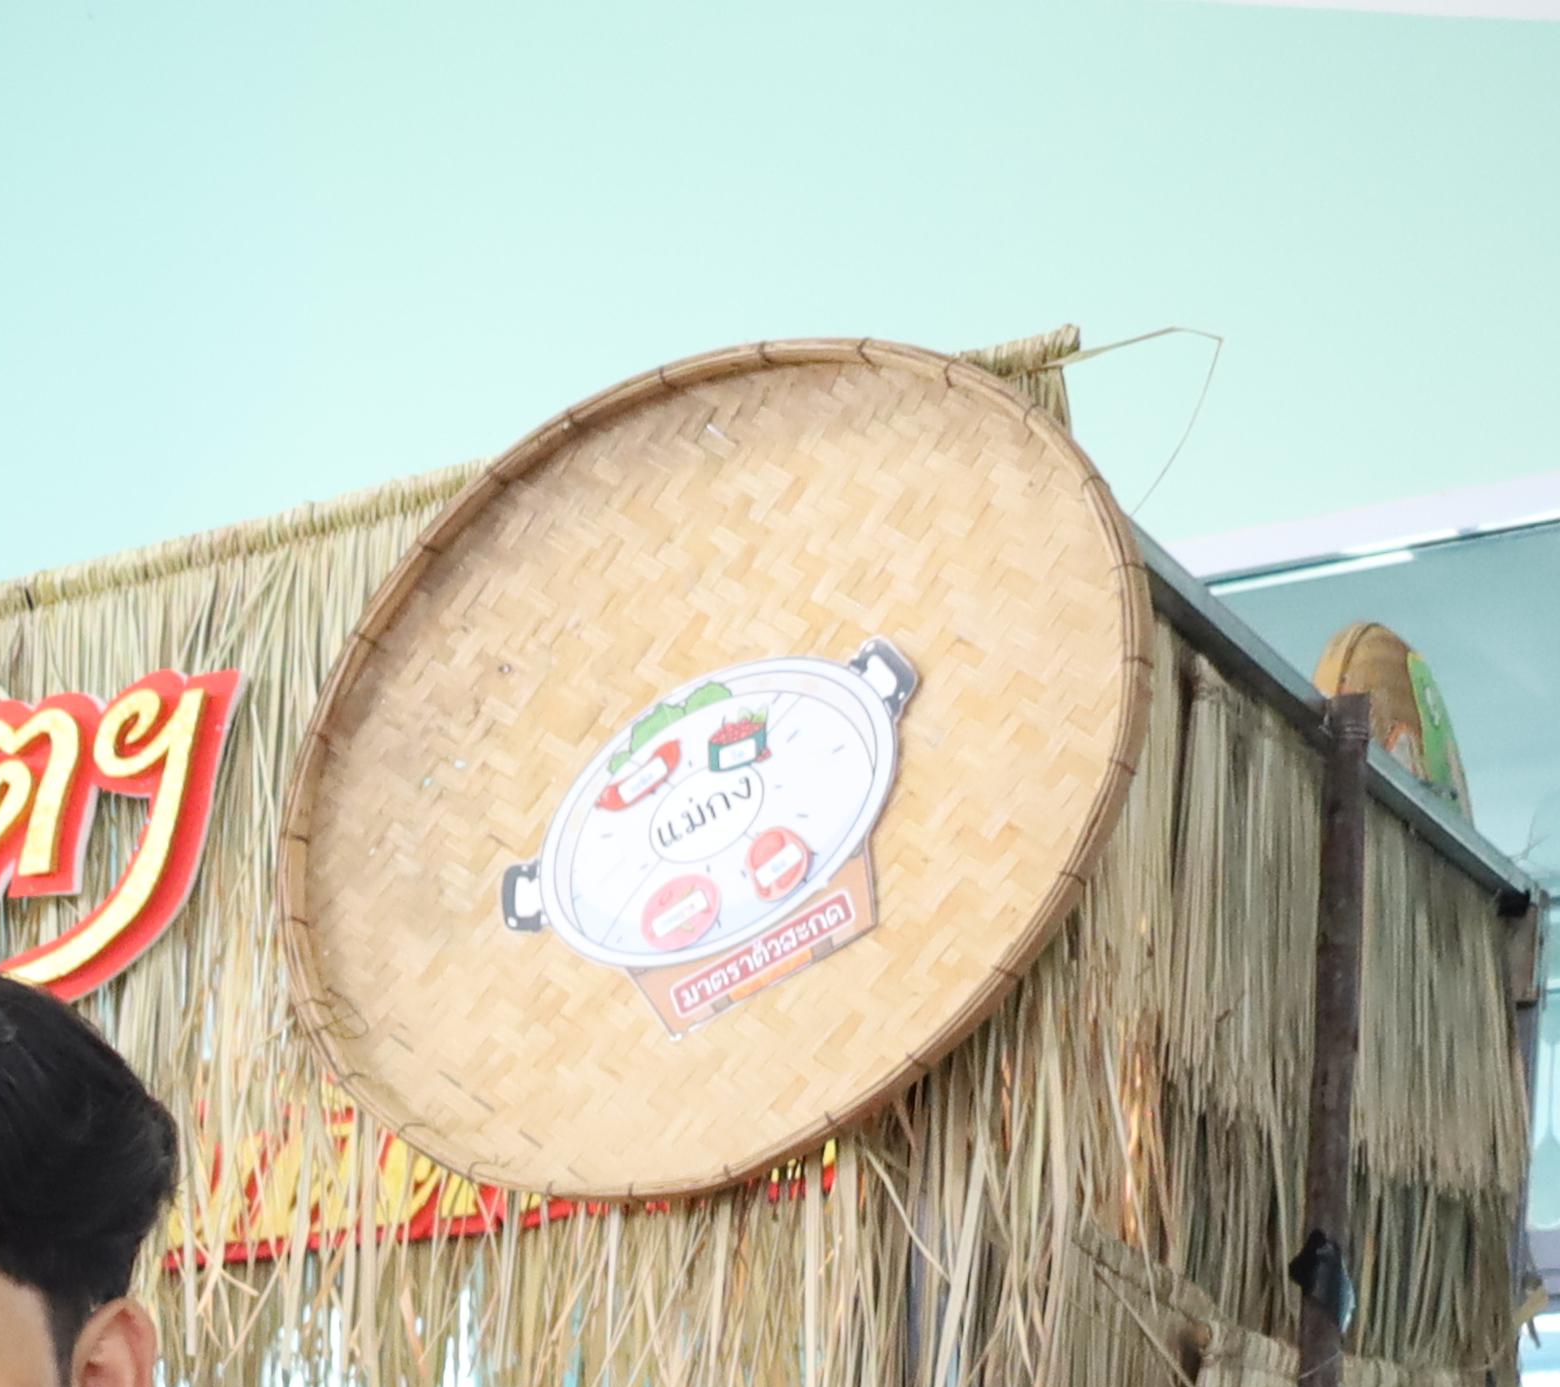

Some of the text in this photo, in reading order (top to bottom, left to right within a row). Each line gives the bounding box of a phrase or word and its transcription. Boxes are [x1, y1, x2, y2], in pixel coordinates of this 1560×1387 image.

[680, 901, 846, 1008] มาตราตัวสะกด
